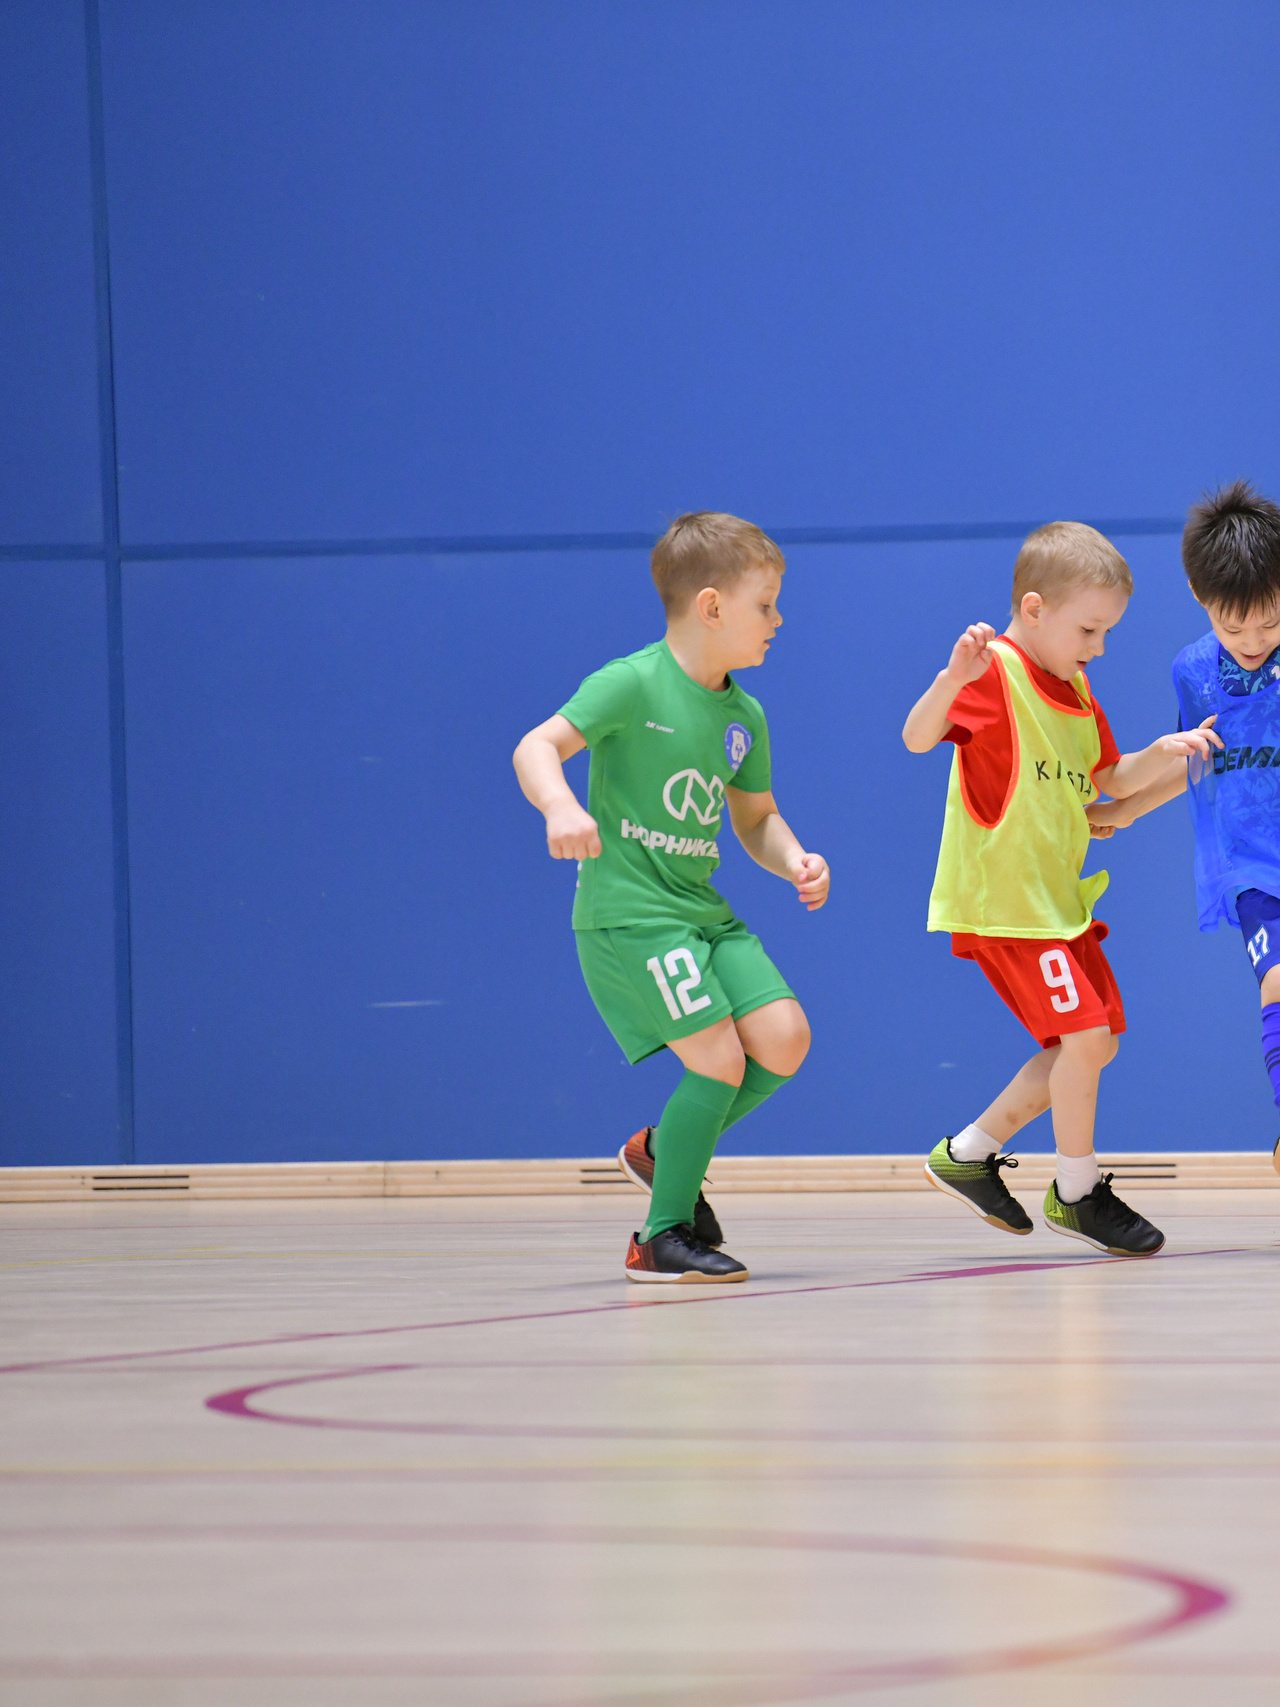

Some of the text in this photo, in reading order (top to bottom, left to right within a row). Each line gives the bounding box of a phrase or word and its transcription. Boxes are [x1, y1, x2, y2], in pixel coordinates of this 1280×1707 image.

[1247, 925, 1270, 967] 17
[646, 947, 712, 1021] 12
[1038, 949, 1080, 1013] 9
